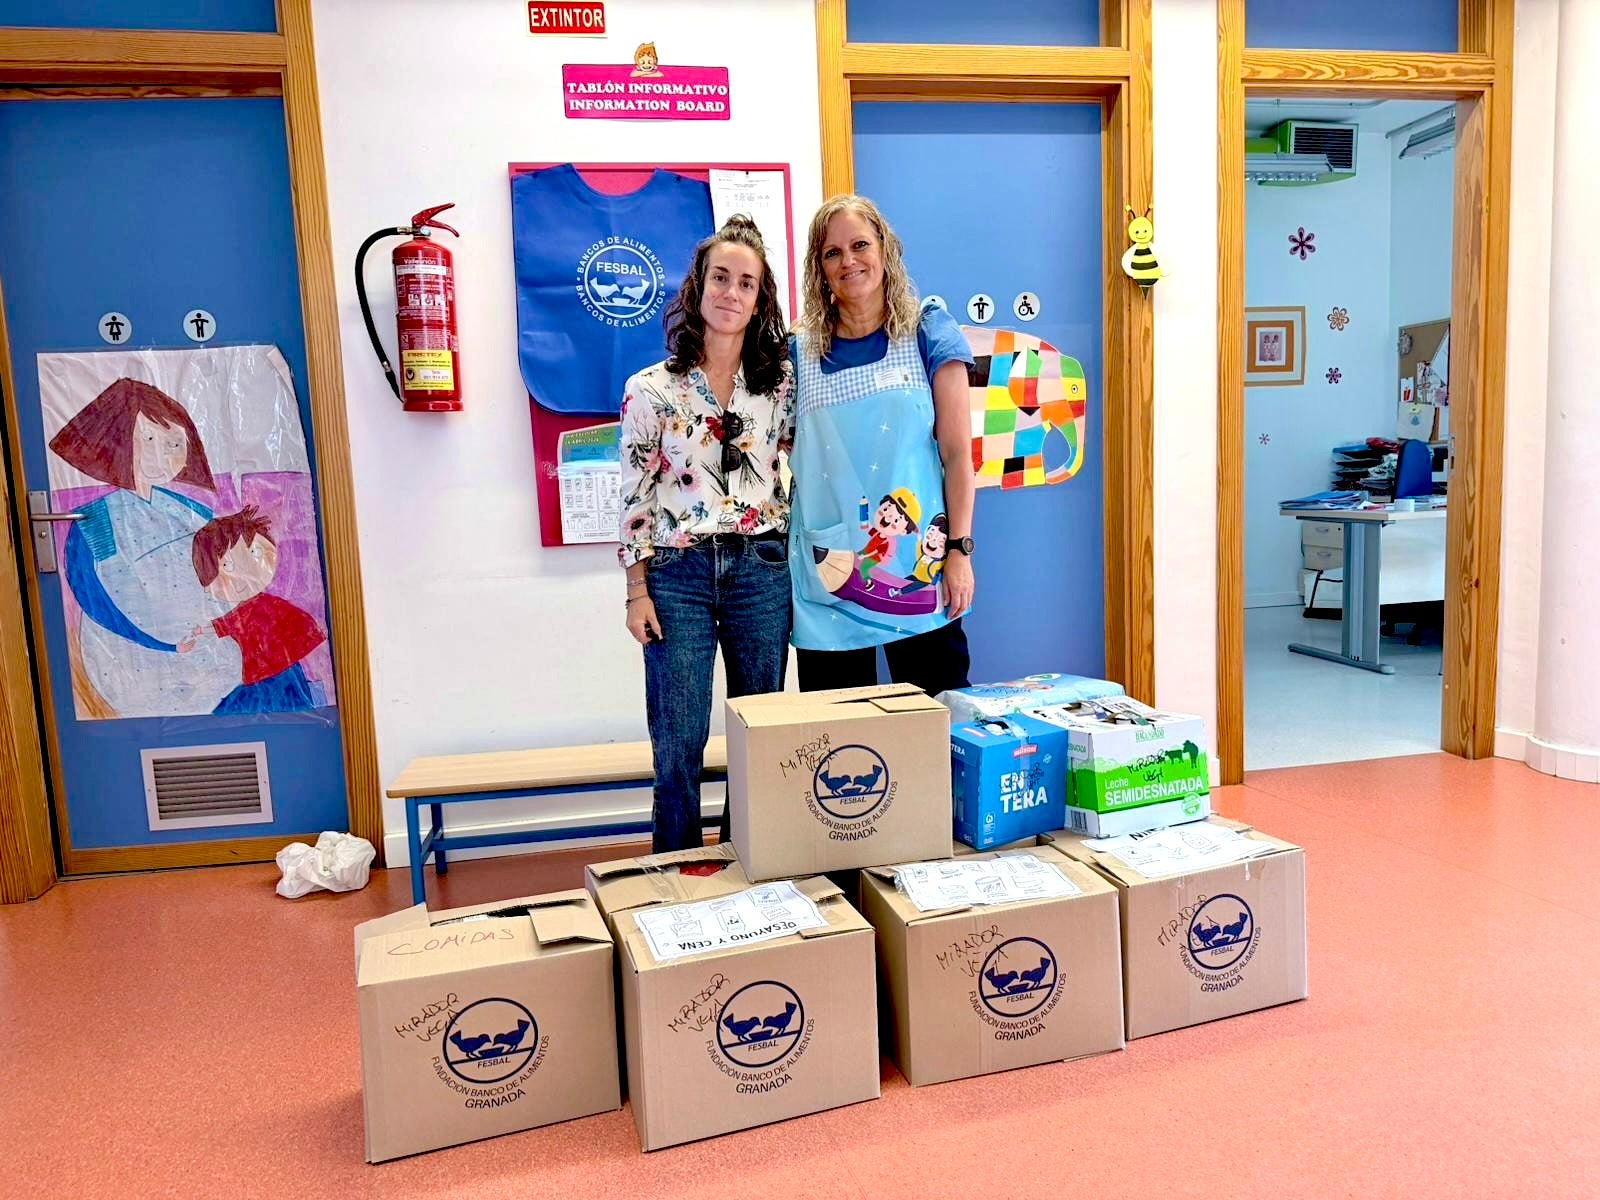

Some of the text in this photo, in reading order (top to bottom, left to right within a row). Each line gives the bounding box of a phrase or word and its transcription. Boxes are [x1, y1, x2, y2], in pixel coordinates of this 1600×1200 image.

[531, 7, 604, 28] EXTINTOR
[567, 80, 728, 96] TABLÓN INFORMATIVO
[569, 100, 725, 112] INFORMATION BOARD
[577, 236, 665, 280] BANCOS DE ALIMENTOS
[596, 261, 646, 276] FESBAL
[576, 285, 666, 328] BANCOS DE ALIMENTOS
[1000, 771, 1025, 794] EN
[1105, 777, 1129, 790] Leche
[1105, 777, 1203, 806] SEMIDESNATADA
[833, 822, 861, 831] BANCO
[861, 819, 873, 828] DE
[872, 780, 898, 823] ALIMENTOS
[1000, 786, 1048, 814] TERA
[828, 826, 878, 841] GRANADA
[730, 921, 797, 941] DESAYUNO
[678, 940, 712, 950] CENA
[1205, 973, 1230, 982] BANCO
[1230, 967, 1240, 977] DE
[1240, 927, 1262, 970] ALIMENTOS
[1201, 974, 1244, 992] GRANADA
[1000, 1021, 1028, 1030] BANCO
[1029, 1015, 1041, 1024] DE
[1040, 973, 1067, 1018] ALIMENTOS
[1006, 993, 1035, 1003] FESBAL
[995, 1023, 1046, 1041] GRANADA
[741, 1071, 773, 1081] BANCO
[774, 1065, 787, 1075] DE
[786, 1019, 815, 1068] ALIMENTOS
[748, 1040, 779, 1052] FESBAL
[471, 1087, 504, 1097] BANCO
[506, 1080, 519, 1091] DE
[520, 1036, 550, 1083] ALIMENTOS
[477, 1057, 511, 1069] FESBAL
[736, 1074, 792, 1094] GRANADA
[465, 1089, 526, 1108] GRANADA
